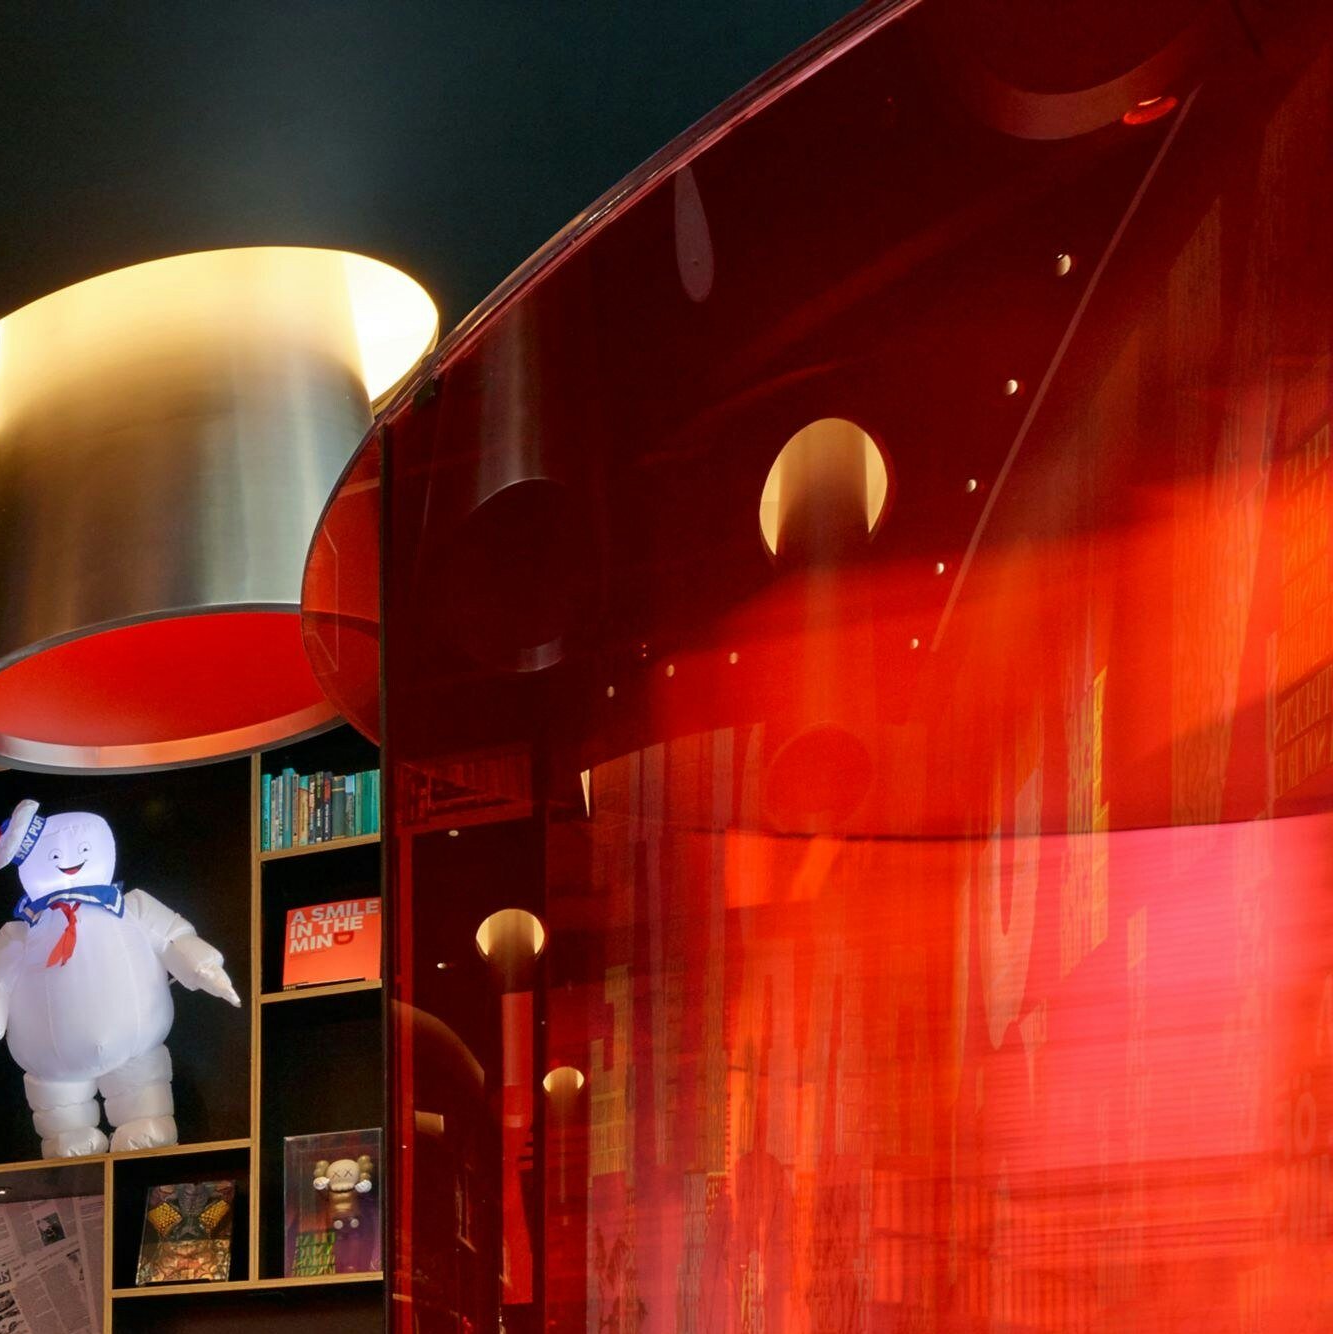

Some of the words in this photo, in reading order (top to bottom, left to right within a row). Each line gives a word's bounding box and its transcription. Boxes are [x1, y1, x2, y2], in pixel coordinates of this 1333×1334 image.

[292, 910, 307, 924] A
[311, 900, 379, 921] SMILE
[290, 922, 312, 939] IN
[318, 915, 364, 935] THE
